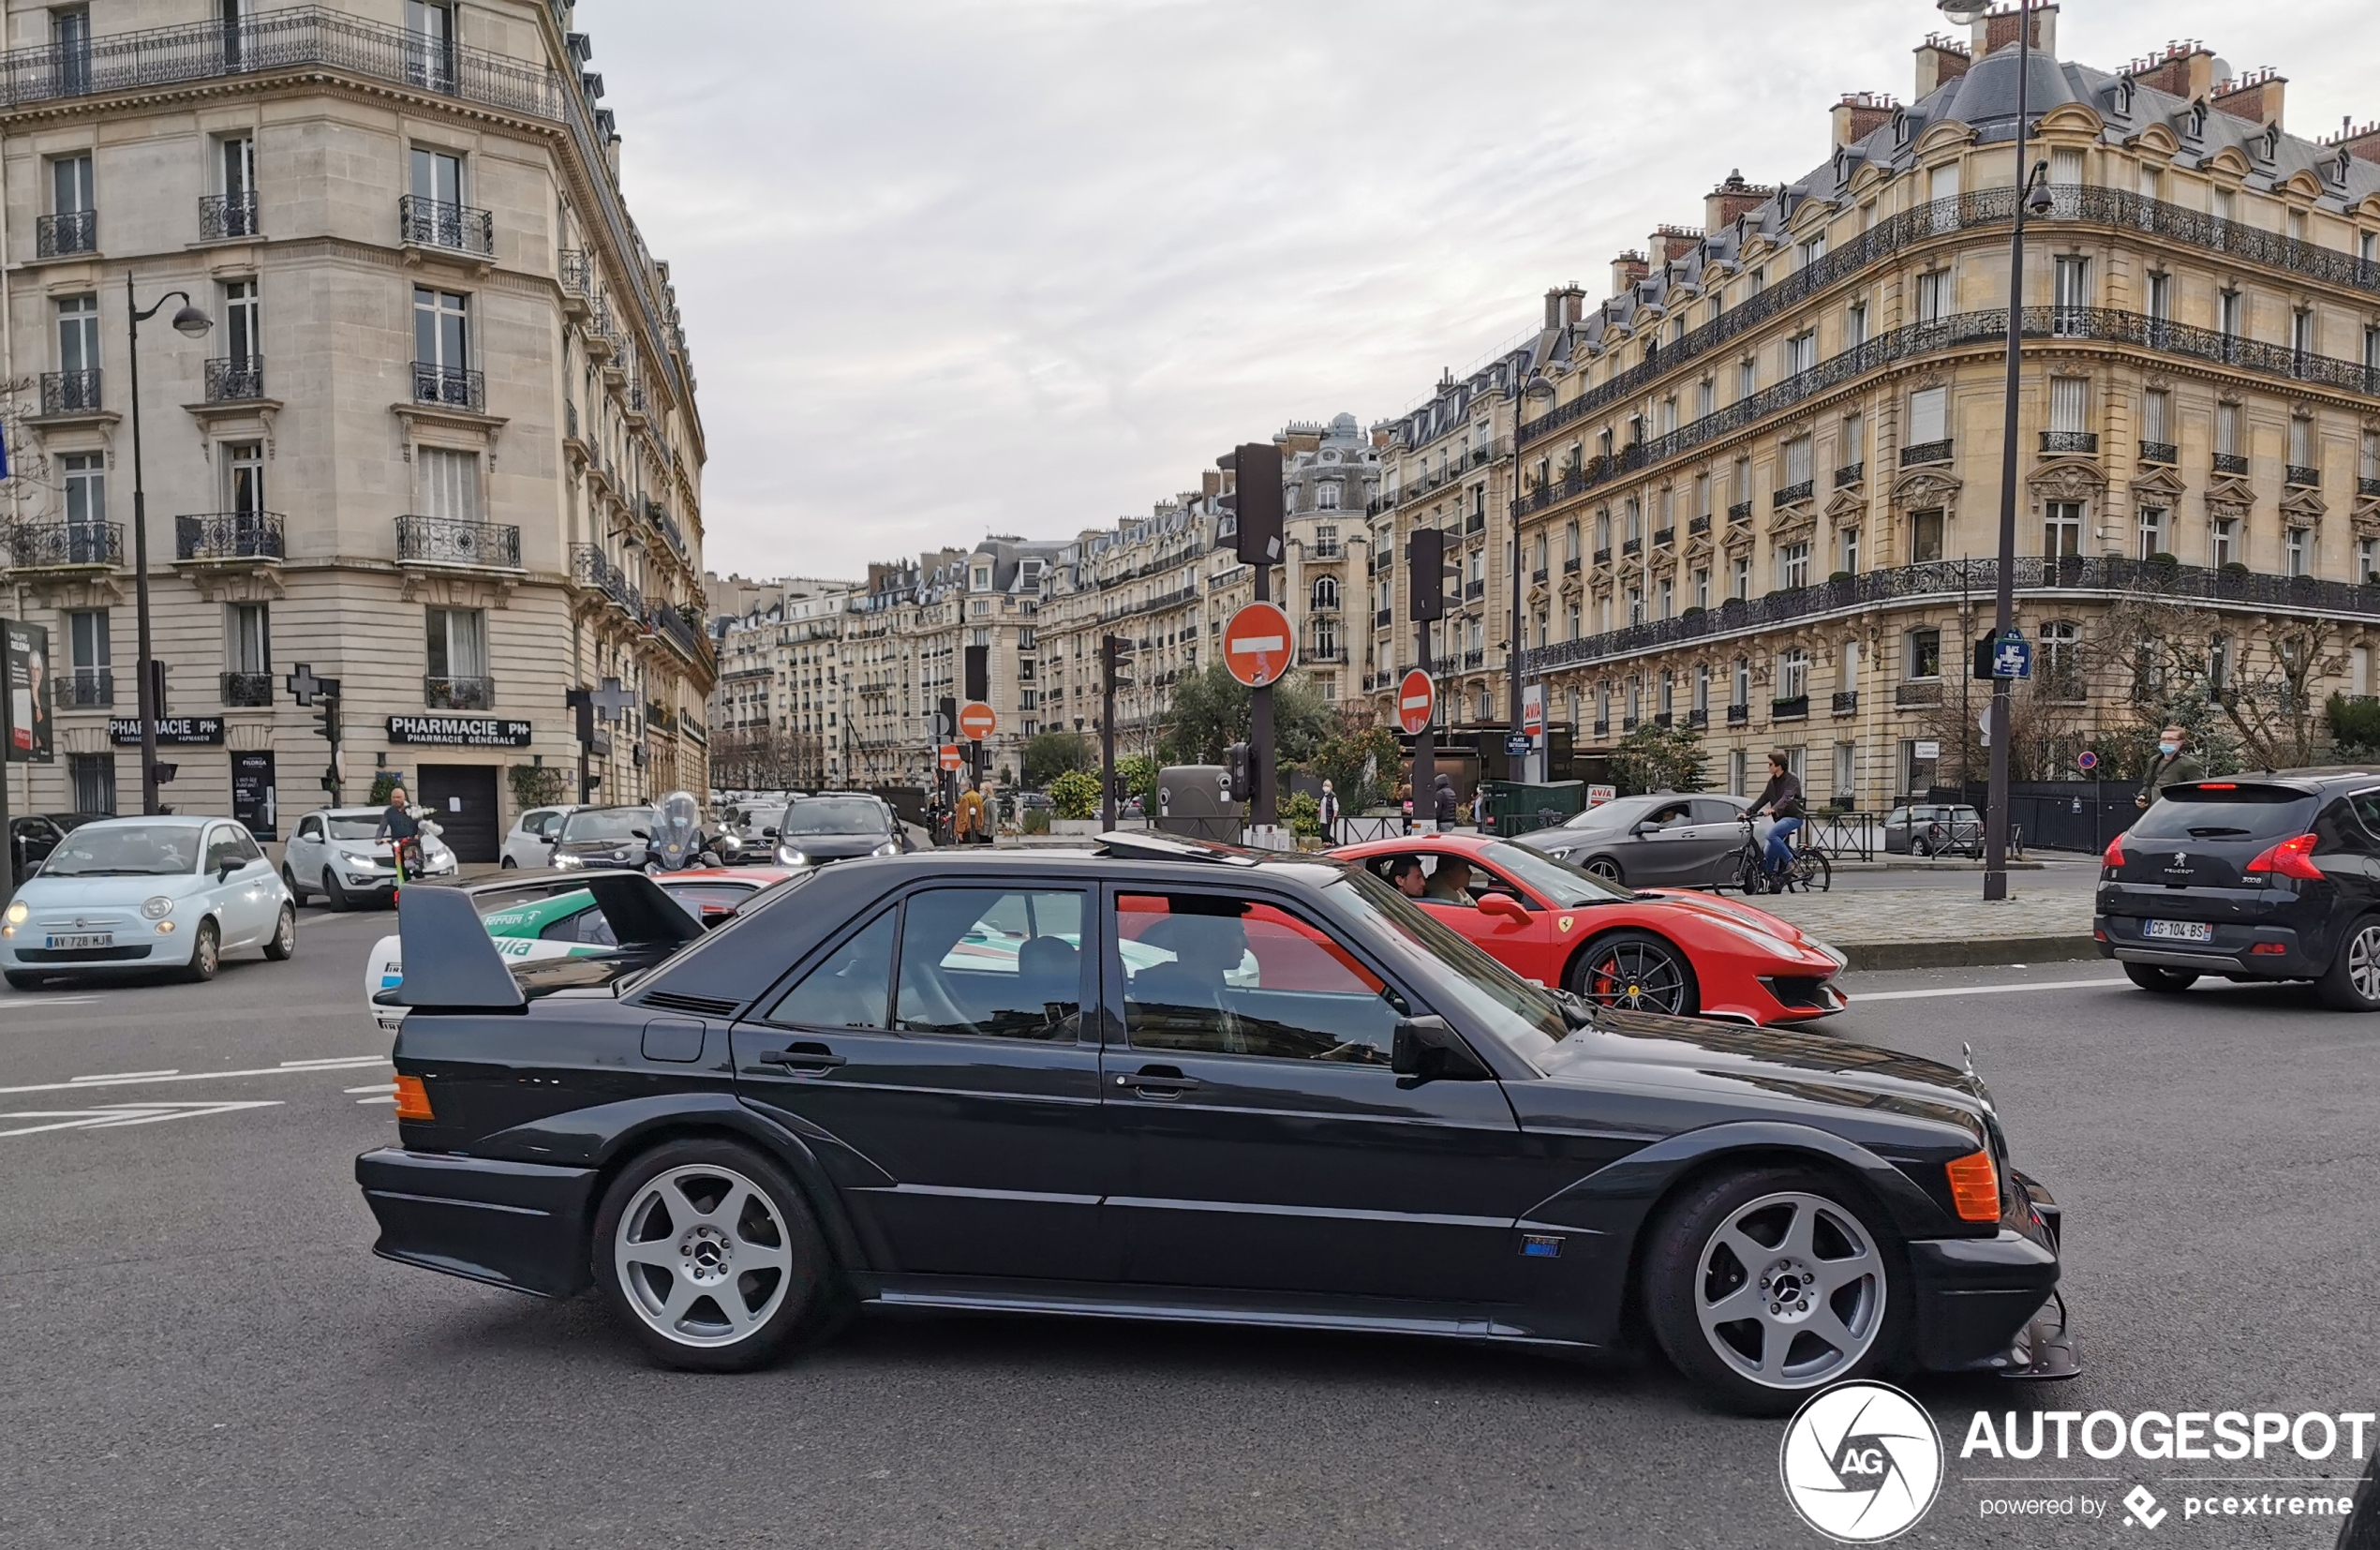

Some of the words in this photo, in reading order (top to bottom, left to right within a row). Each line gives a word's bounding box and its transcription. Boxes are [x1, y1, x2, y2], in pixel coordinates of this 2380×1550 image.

[110, 719, 192, 735] PHAACIE
[392, 718, 498, 736] PHARMACIE
[407, 733, 464, 744] PHARMACIE
[468, 734, 516, 745] GÉNÉRALE
[483, 913, 525, 926] Ferrari
[2151, 922, 2204, 937] CG-104-BS
[53, 936, 66, 947] AV
